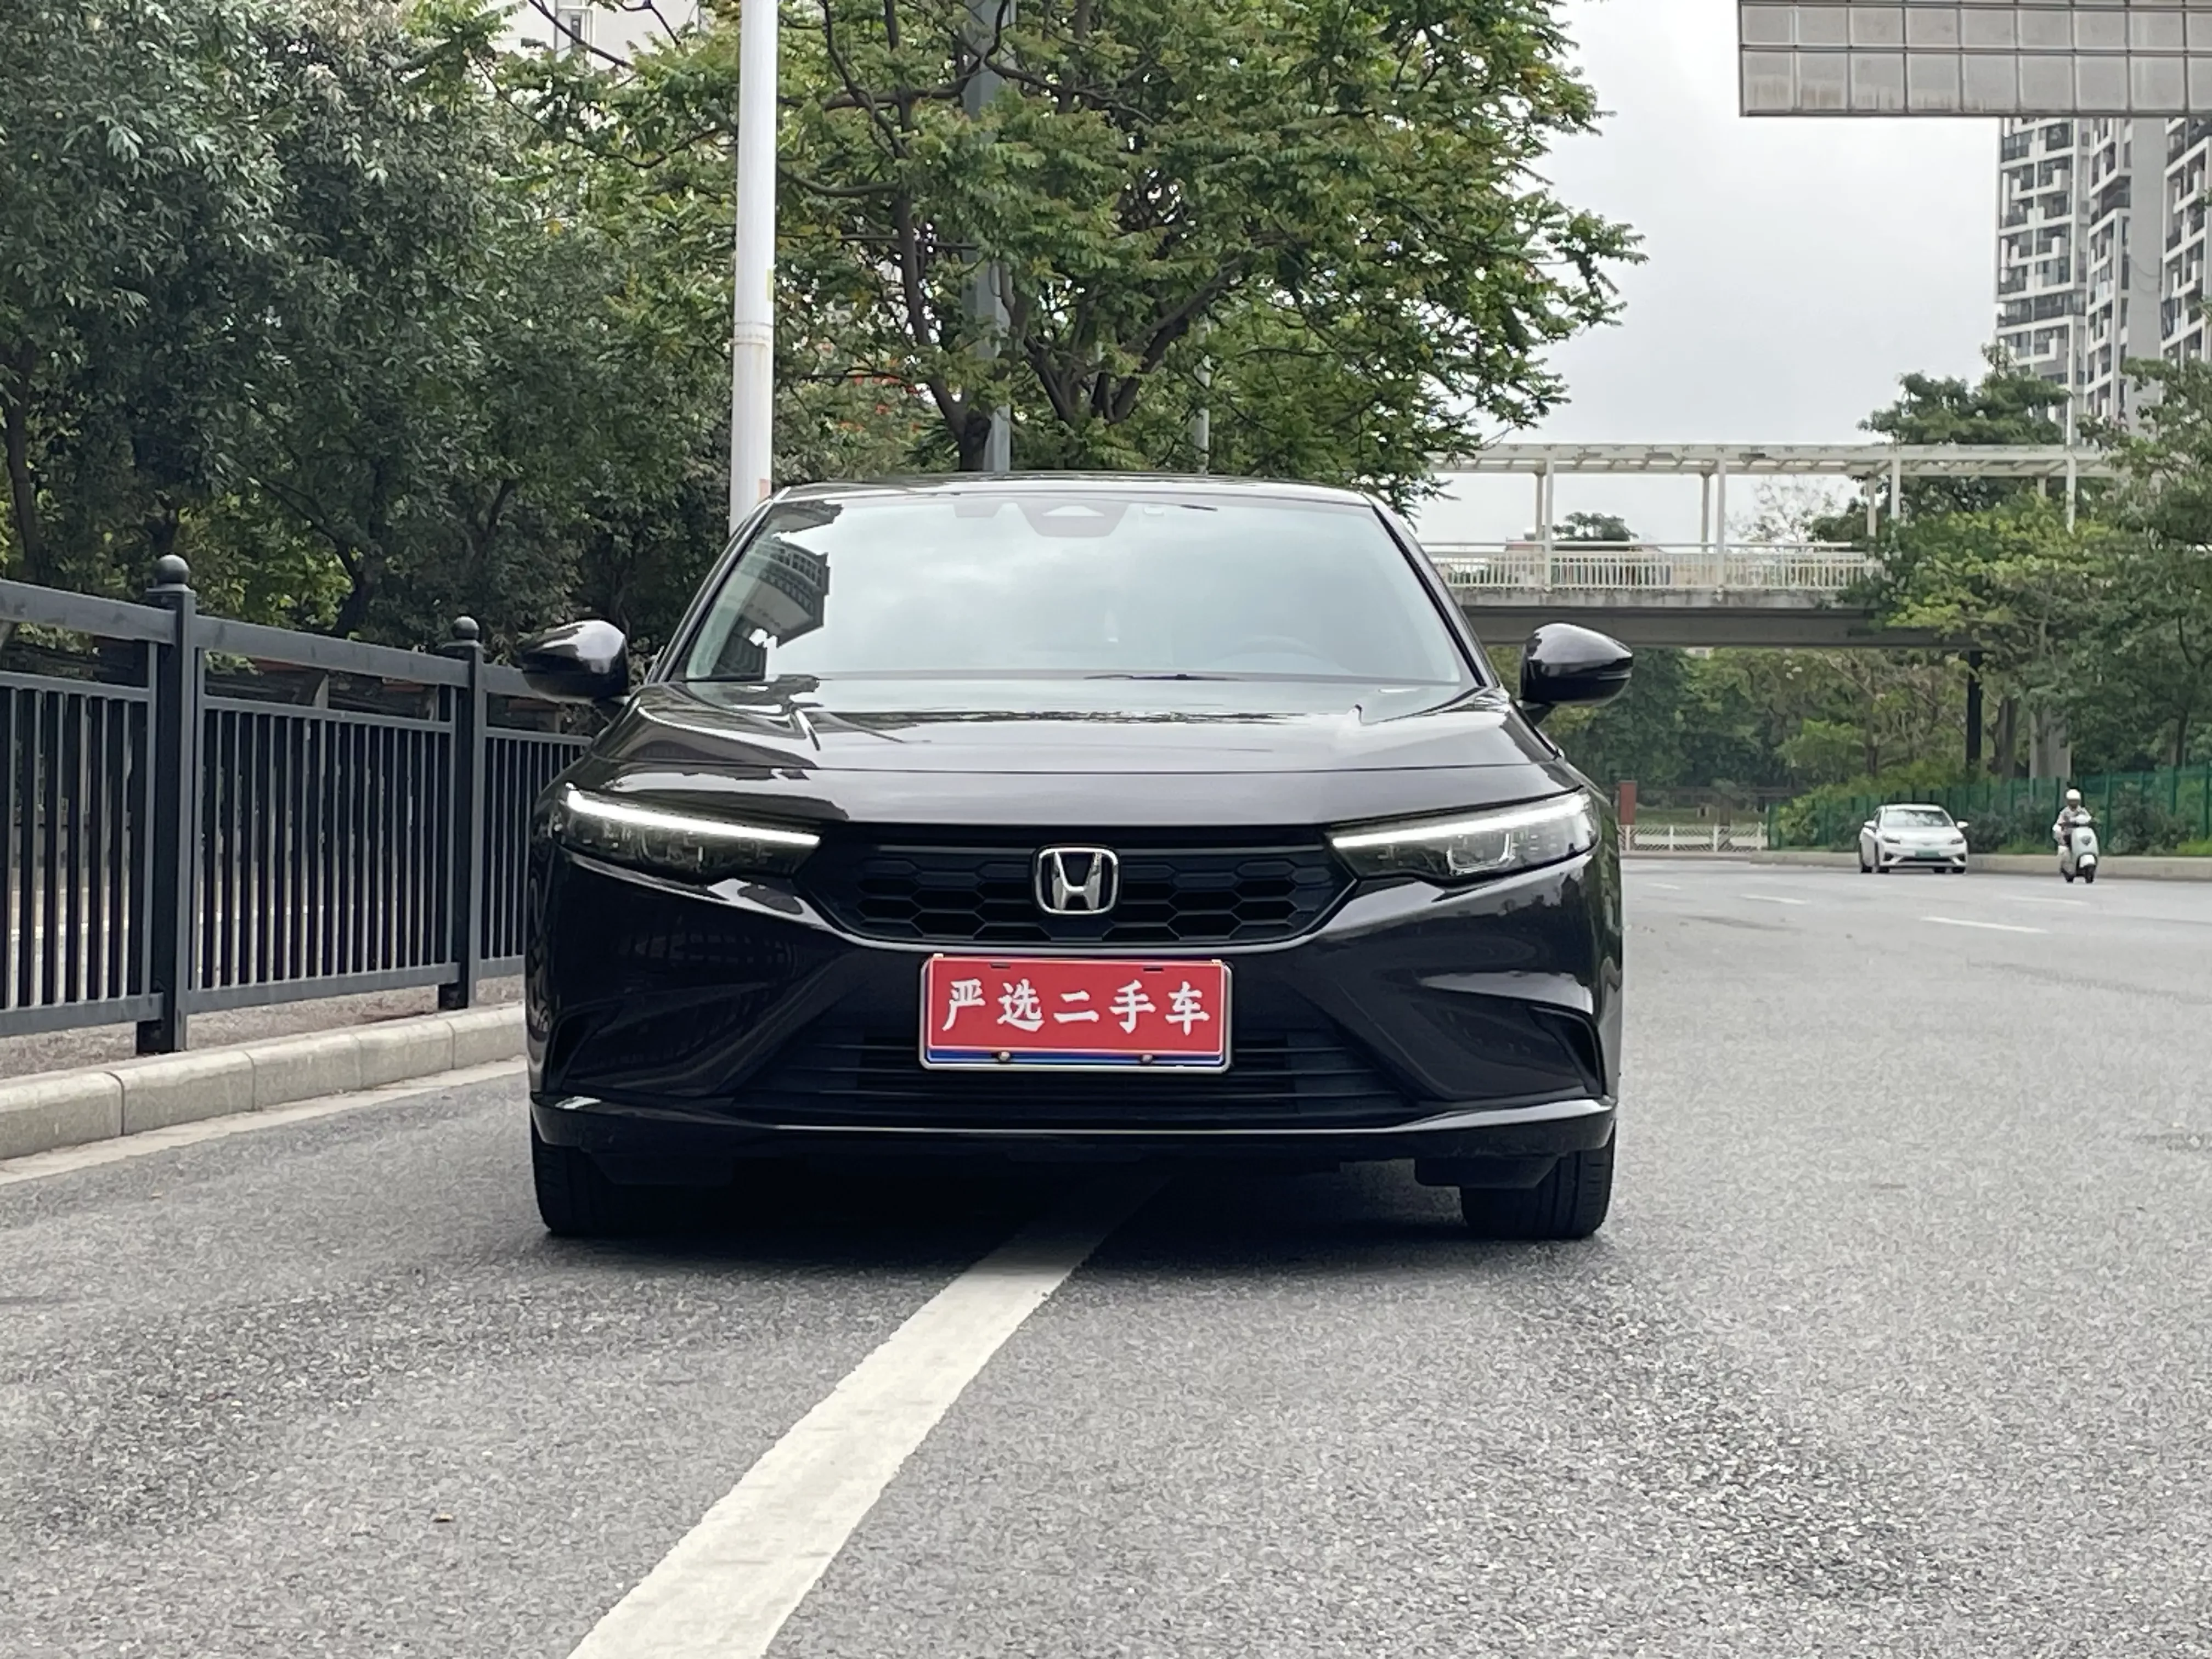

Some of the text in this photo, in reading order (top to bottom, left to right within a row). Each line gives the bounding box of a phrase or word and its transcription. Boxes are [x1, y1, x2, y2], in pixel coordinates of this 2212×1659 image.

[942, 978, 1210, 1035] 严选二手车
